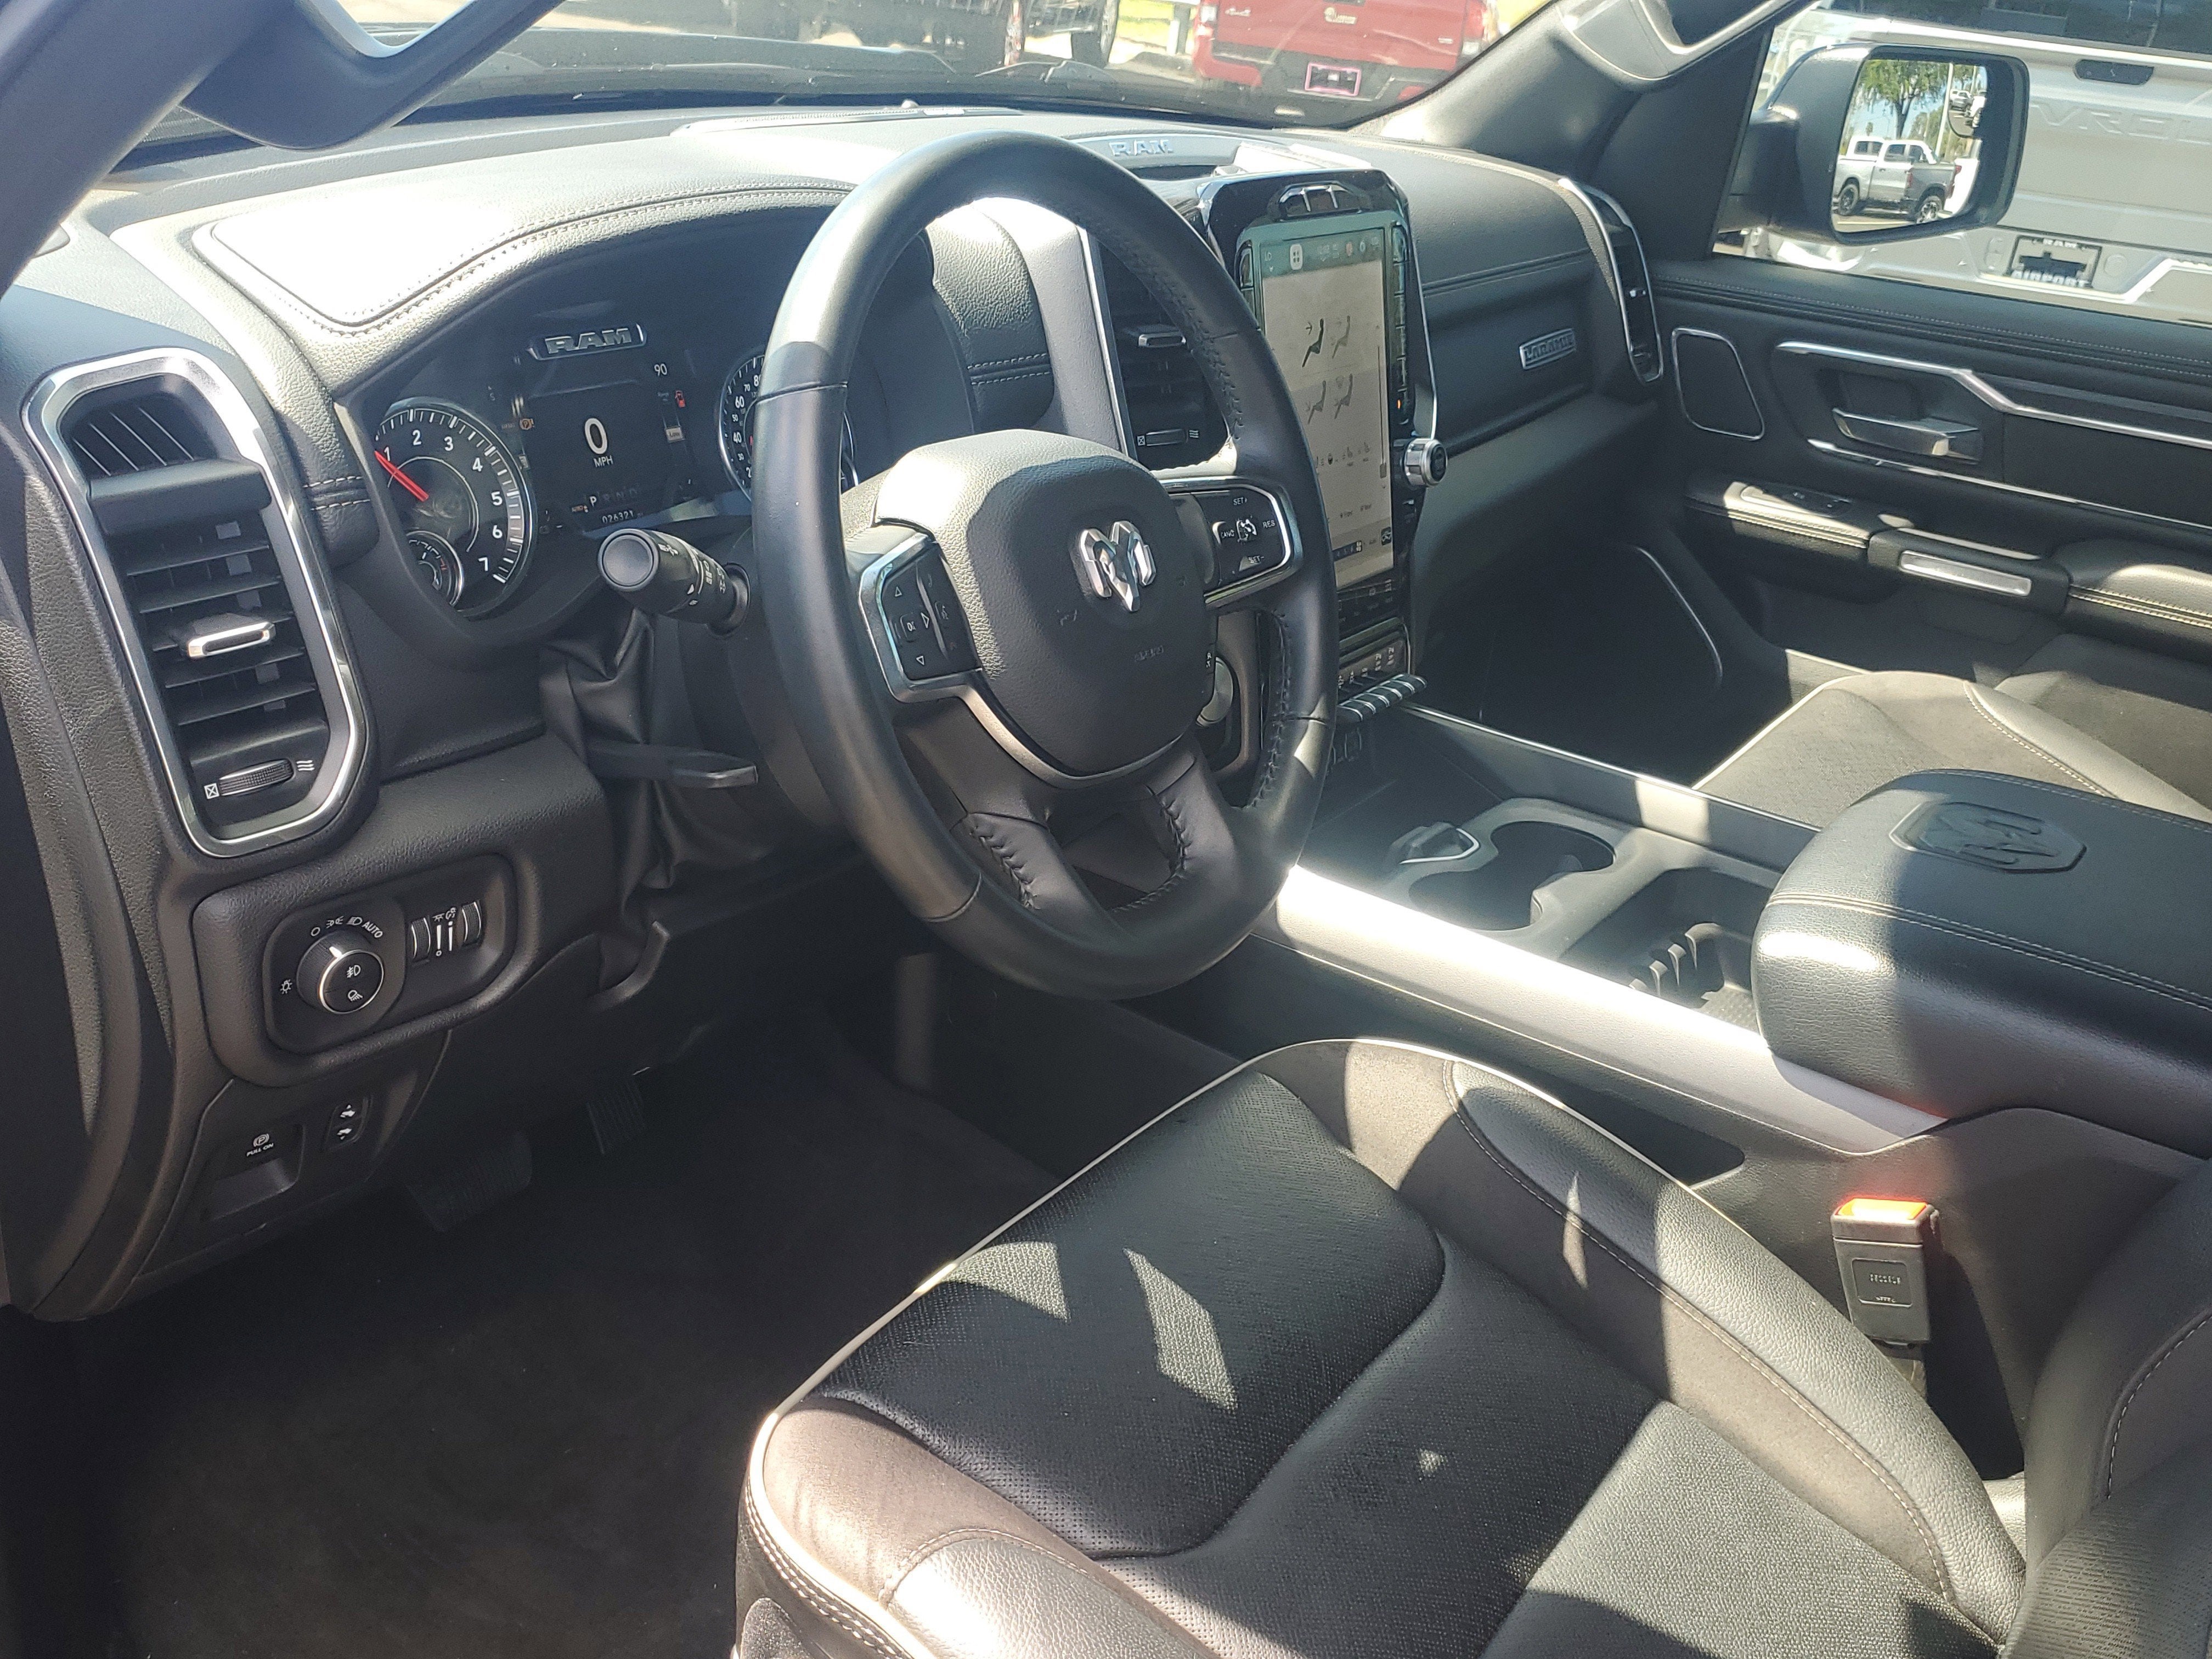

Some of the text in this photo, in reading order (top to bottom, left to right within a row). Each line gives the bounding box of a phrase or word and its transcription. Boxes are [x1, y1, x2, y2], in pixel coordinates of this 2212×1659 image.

[1109, 139, 1173, 156] RAM
[545, 328, 631, 354] RAM
[654, 363, 668, 376] 90
[753, 375, 761, 386] 8
[735, 396, 744, 408] 60
[412, 430, 422, 445] 2
[584, 417, 608, 454] 0
[733, 432, 742, 444] 40
[444, 437, 454, 452] 3
[385, 447, 391, 461] 1
[594, 455, 613, 467] MPH
[472, 458, 483, 472] 4
[491, 492, 503, 505] 5
[1263, 520, 1276, 528] RES
[492, 525, 503, 539] 6
[478, 557, 488, 571] 7
[362, 921, 383, 938] AUTO
